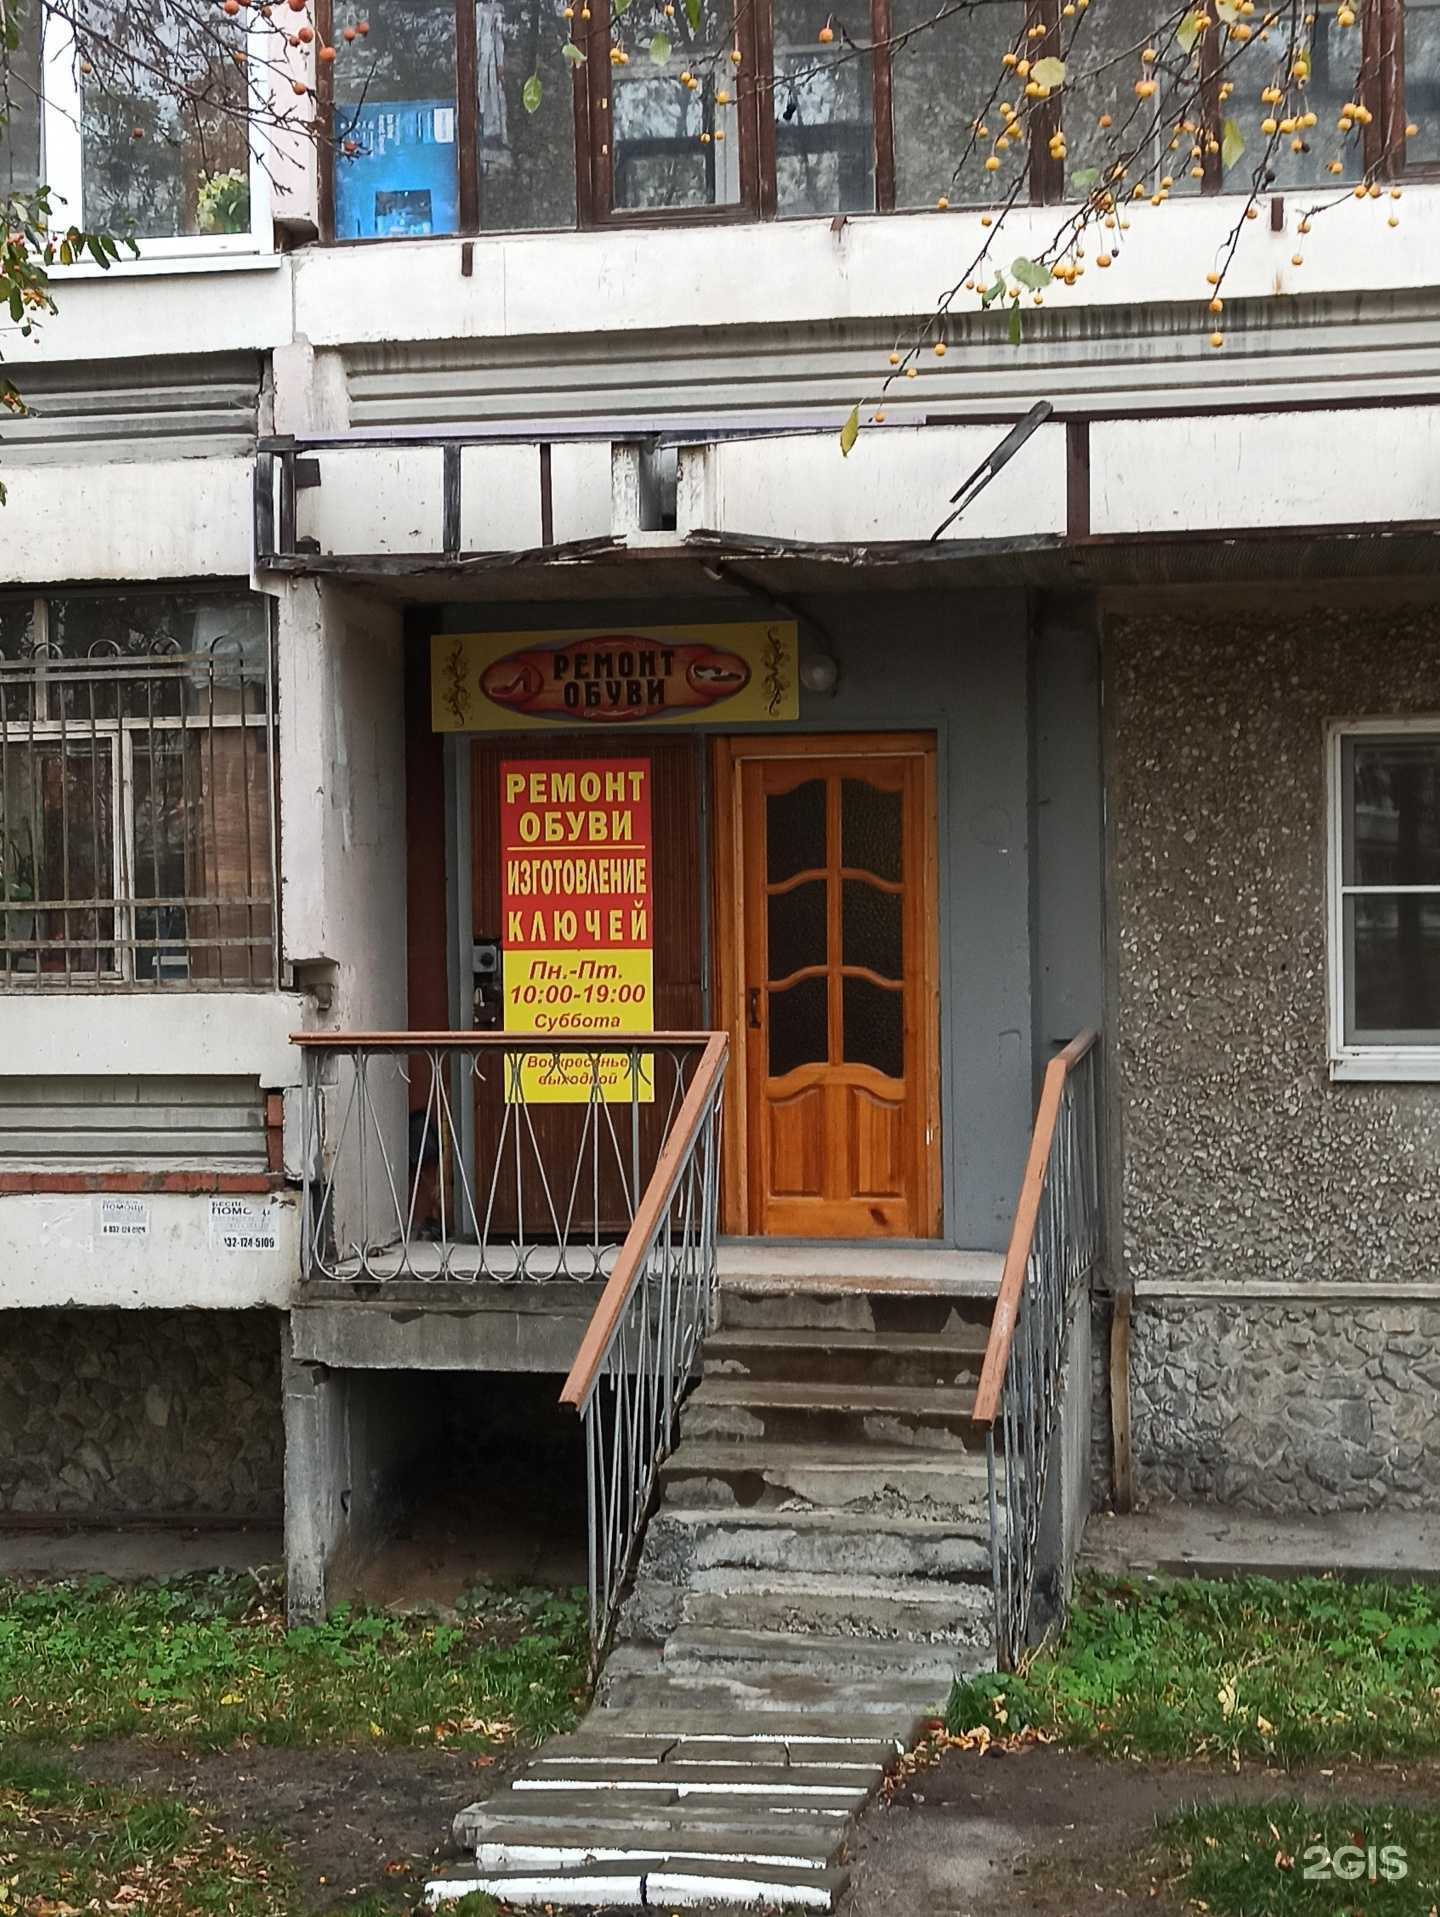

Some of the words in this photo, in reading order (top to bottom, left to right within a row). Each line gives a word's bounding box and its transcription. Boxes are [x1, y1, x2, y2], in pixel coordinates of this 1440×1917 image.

[553, 650, 675, 680] РЕМОНТ
[563, 678, 666, 708] ОБУВИ
[506, 771, 645, 804] РЕМОНТ
[519, 810, 632, 843] ОБУВИ
[507, 858, 646, 896] ИЗГОТОВЛЕНИЕ
[508, 899, 647, 943] КЛЮЧЕЙ
[529, 960, 623, 981] Пн.-Пт.
[511, 984, 646, 1005] 10:00-19:00
[534, 1013, 621, 1032] Суббота
